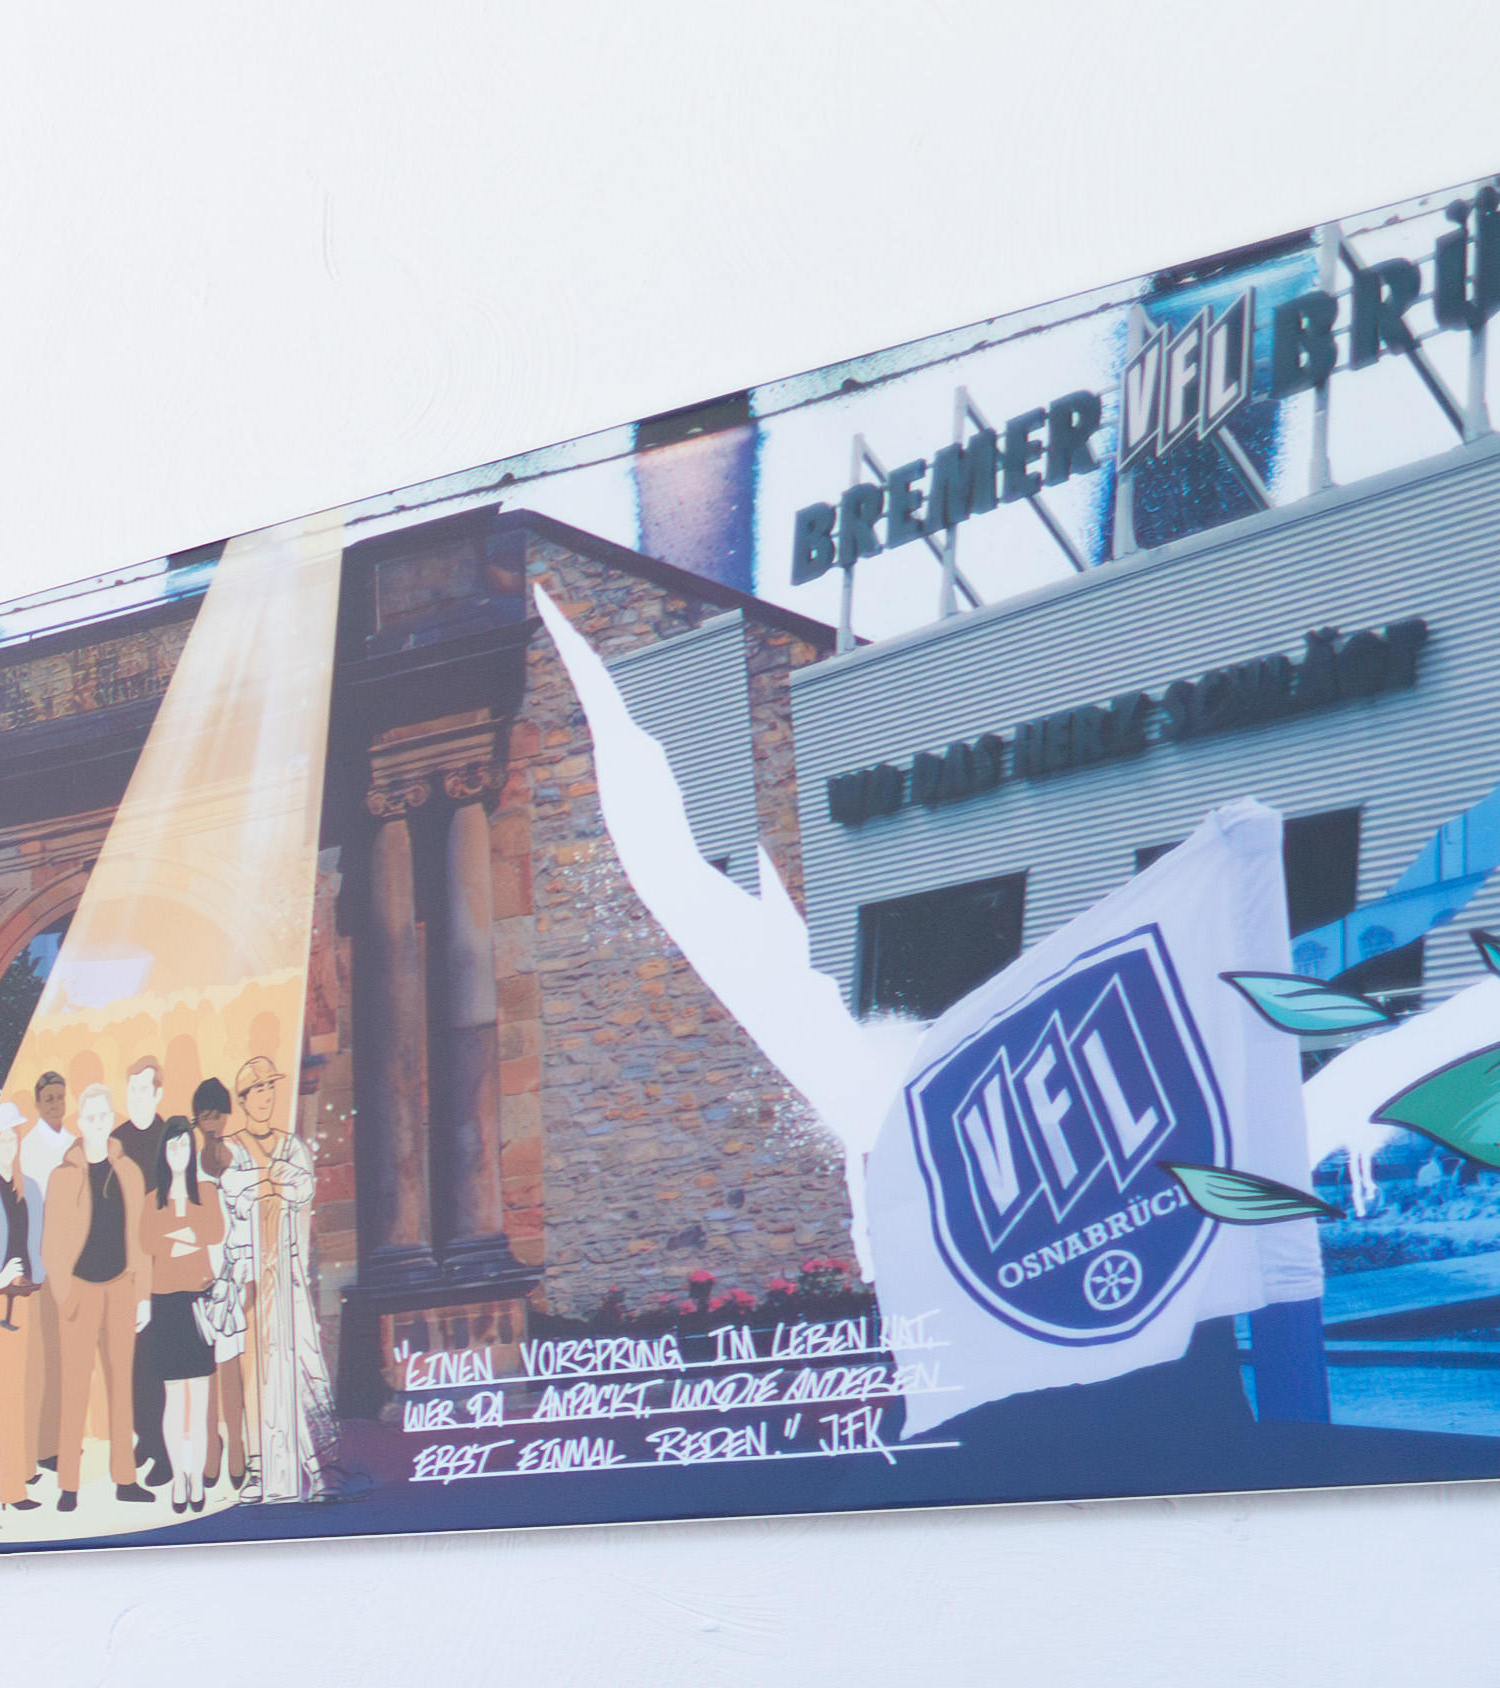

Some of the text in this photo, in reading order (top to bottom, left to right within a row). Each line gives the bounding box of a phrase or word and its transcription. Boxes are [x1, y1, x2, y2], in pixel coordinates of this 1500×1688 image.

[792, 389, 1102, 586] BREMER
[960, 1010, 1164, 1226] VFL
[520, 1334, 686, 1378] VORSPRUNG
[708, 1324, 757, 1366] IM
[772, 1315, 868, 1360] LEBEN
[404, 1398, 457, 1431] WER
[466, 1390, 504, 1429] DA
[783, 1361, 941, 1402] ANDEREN
[413, 1438, 516, 1484] ERST
[518, 1436, 627, 1471] EINMAL
